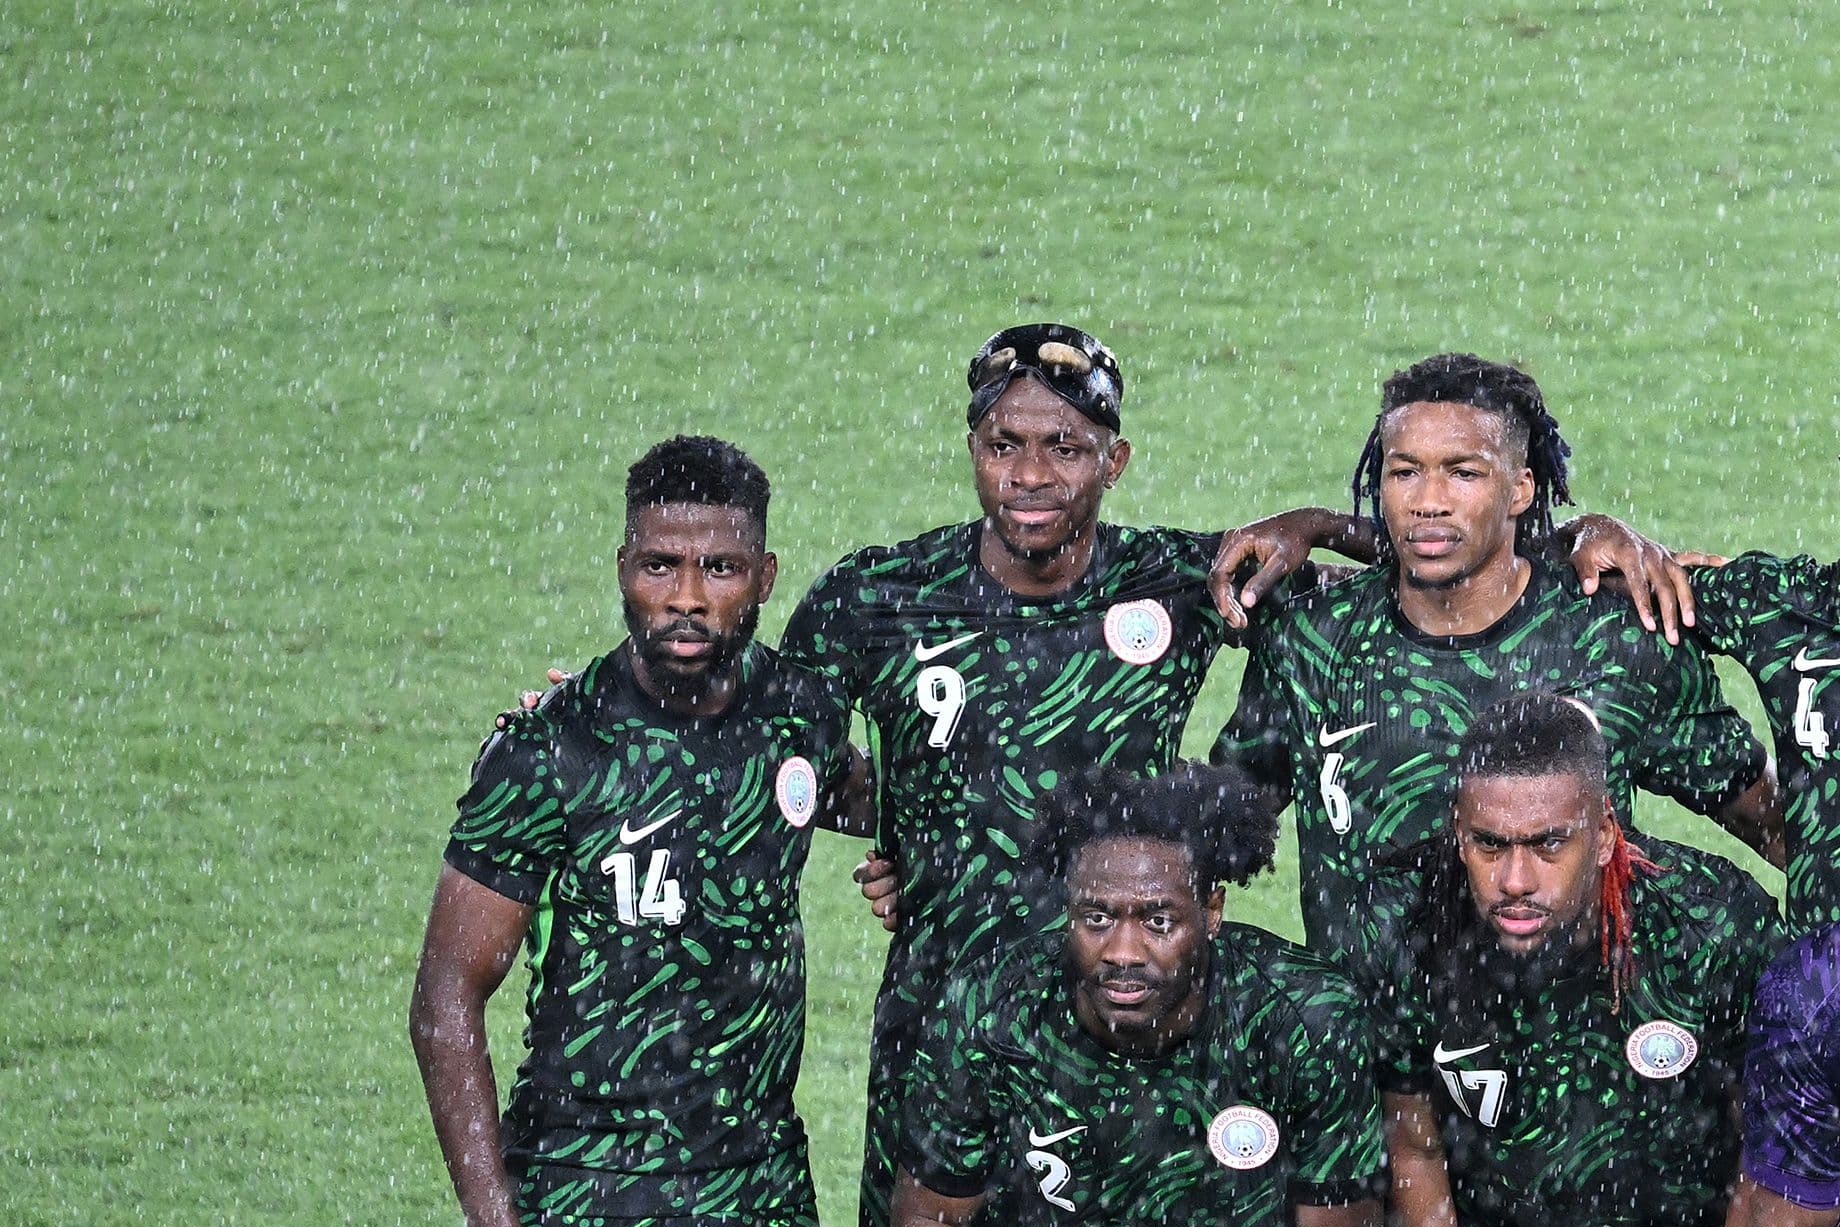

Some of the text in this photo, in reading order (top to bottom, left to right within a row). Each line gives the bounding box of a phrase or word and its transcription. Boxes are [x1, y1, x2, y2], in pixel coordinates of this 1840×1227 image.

[917, 666, 967, 752] 9
[1793, 678, 1830, 758] 4
[1320, 752, 1352, 835] 6
[600, 848, 687, 926] 14
[1026, 1150, 1076, 1212] 2
